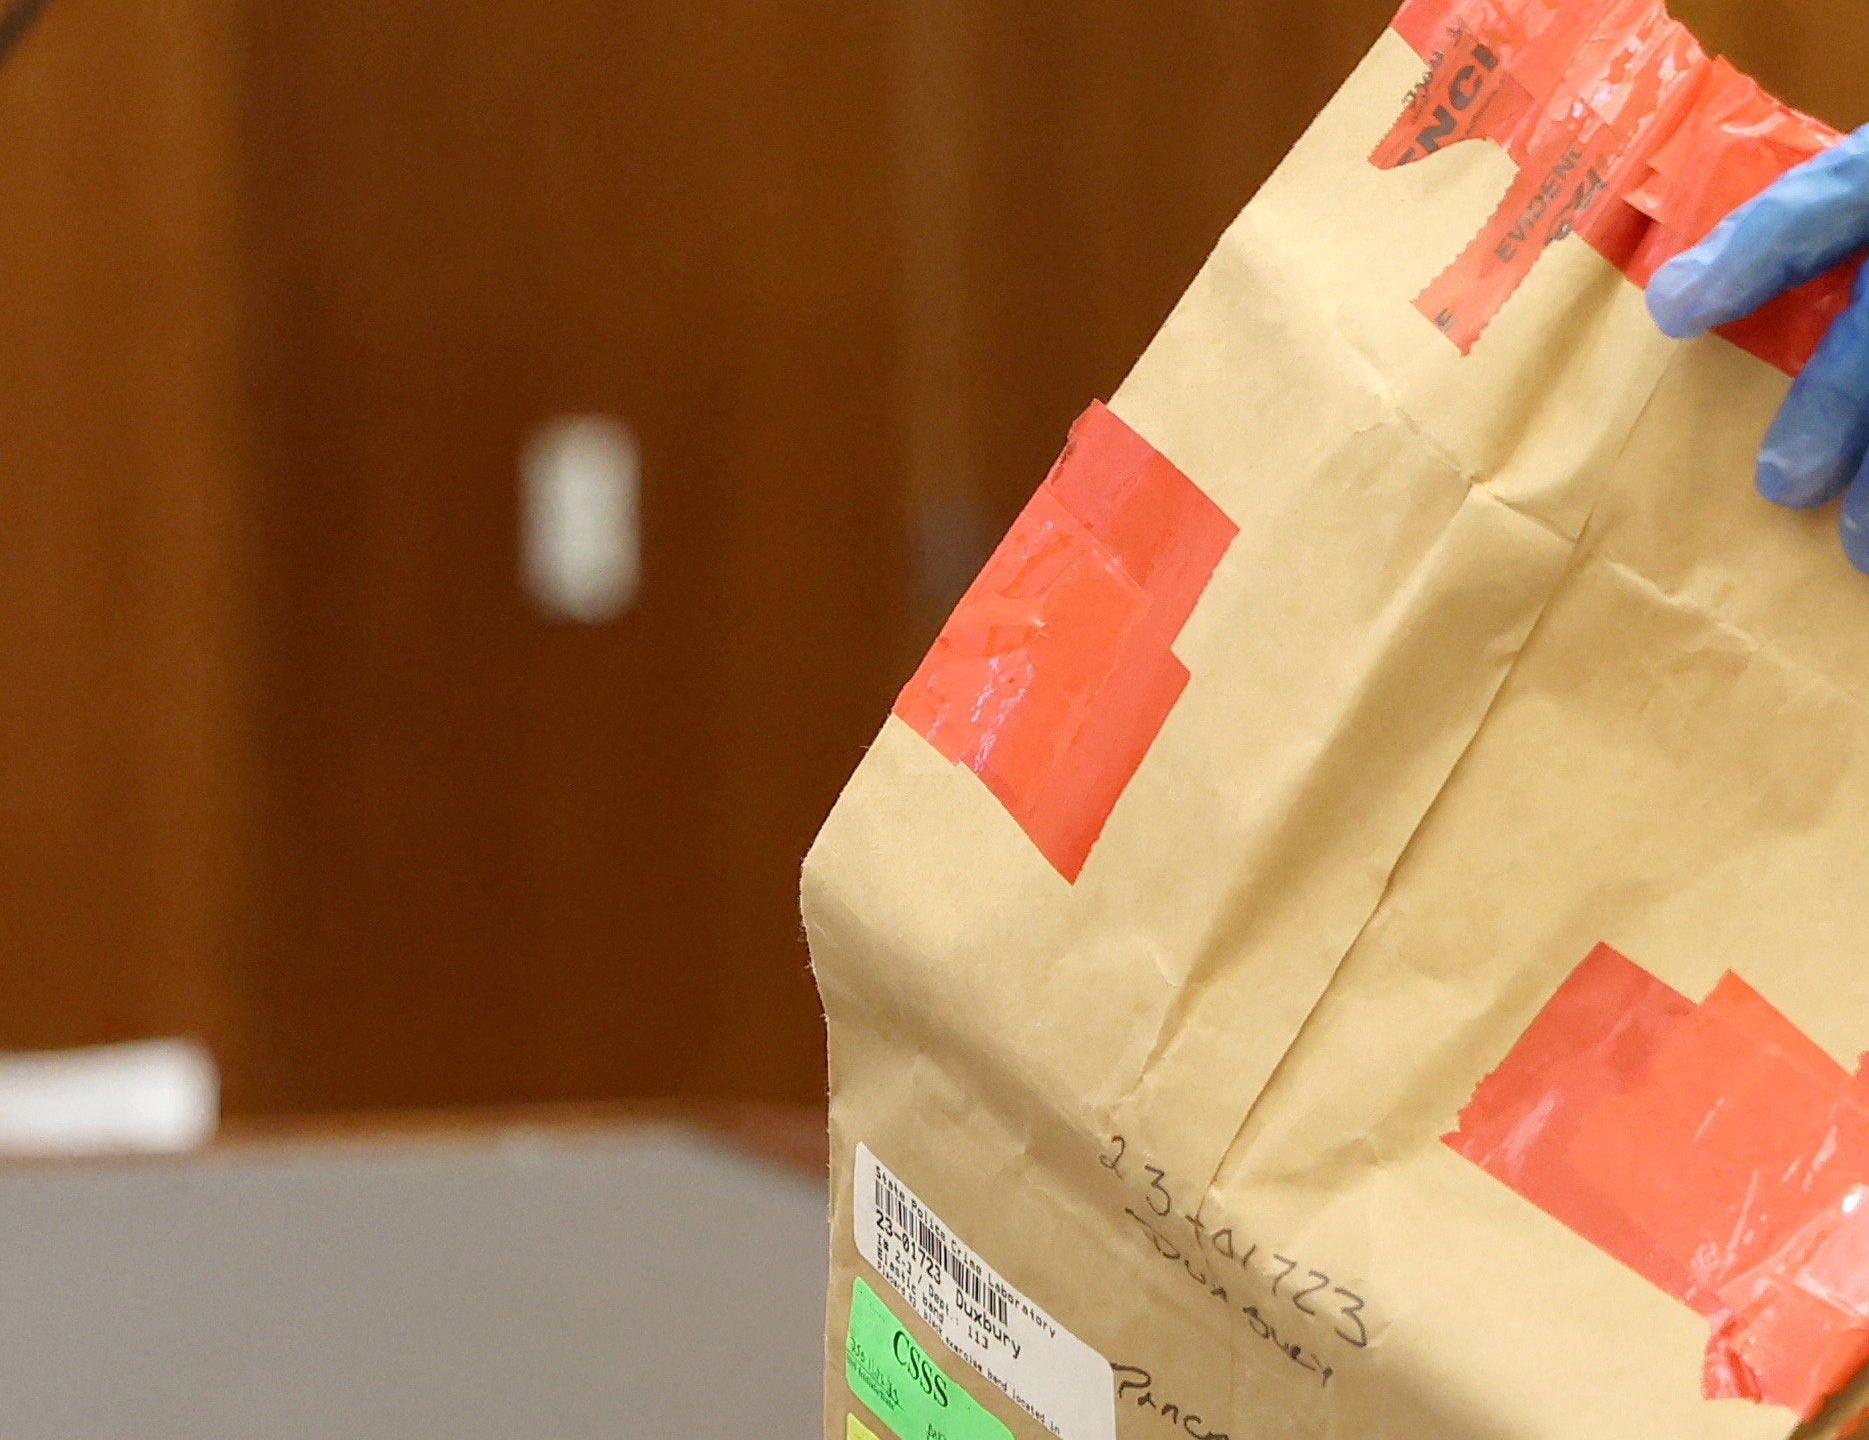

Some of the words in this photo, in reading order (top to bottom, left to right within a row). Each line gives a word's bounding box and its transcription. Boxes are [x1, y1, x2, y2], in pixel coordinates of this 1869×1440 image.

[875, 1166, 905, 1201] State
[911, 1199, 946, 1241] Police
[951, 1238, 983, 1274] Crime
[988, 1274, 1056, 1339] Laboratory
[875, 1212, 942, 1285] 23-01723
[956, 1290, 1022, 1360] Duxbury
[876, 1247, 917, 1295] Elastic
[922, 1291, 945, 1324] band
[893, 1331, 949, 1408] CSSS
[967, 1325, 989, 1350] 113
[987, 1366, 1008, 1392] band
[1050, 1423, 1060, 1435] in
